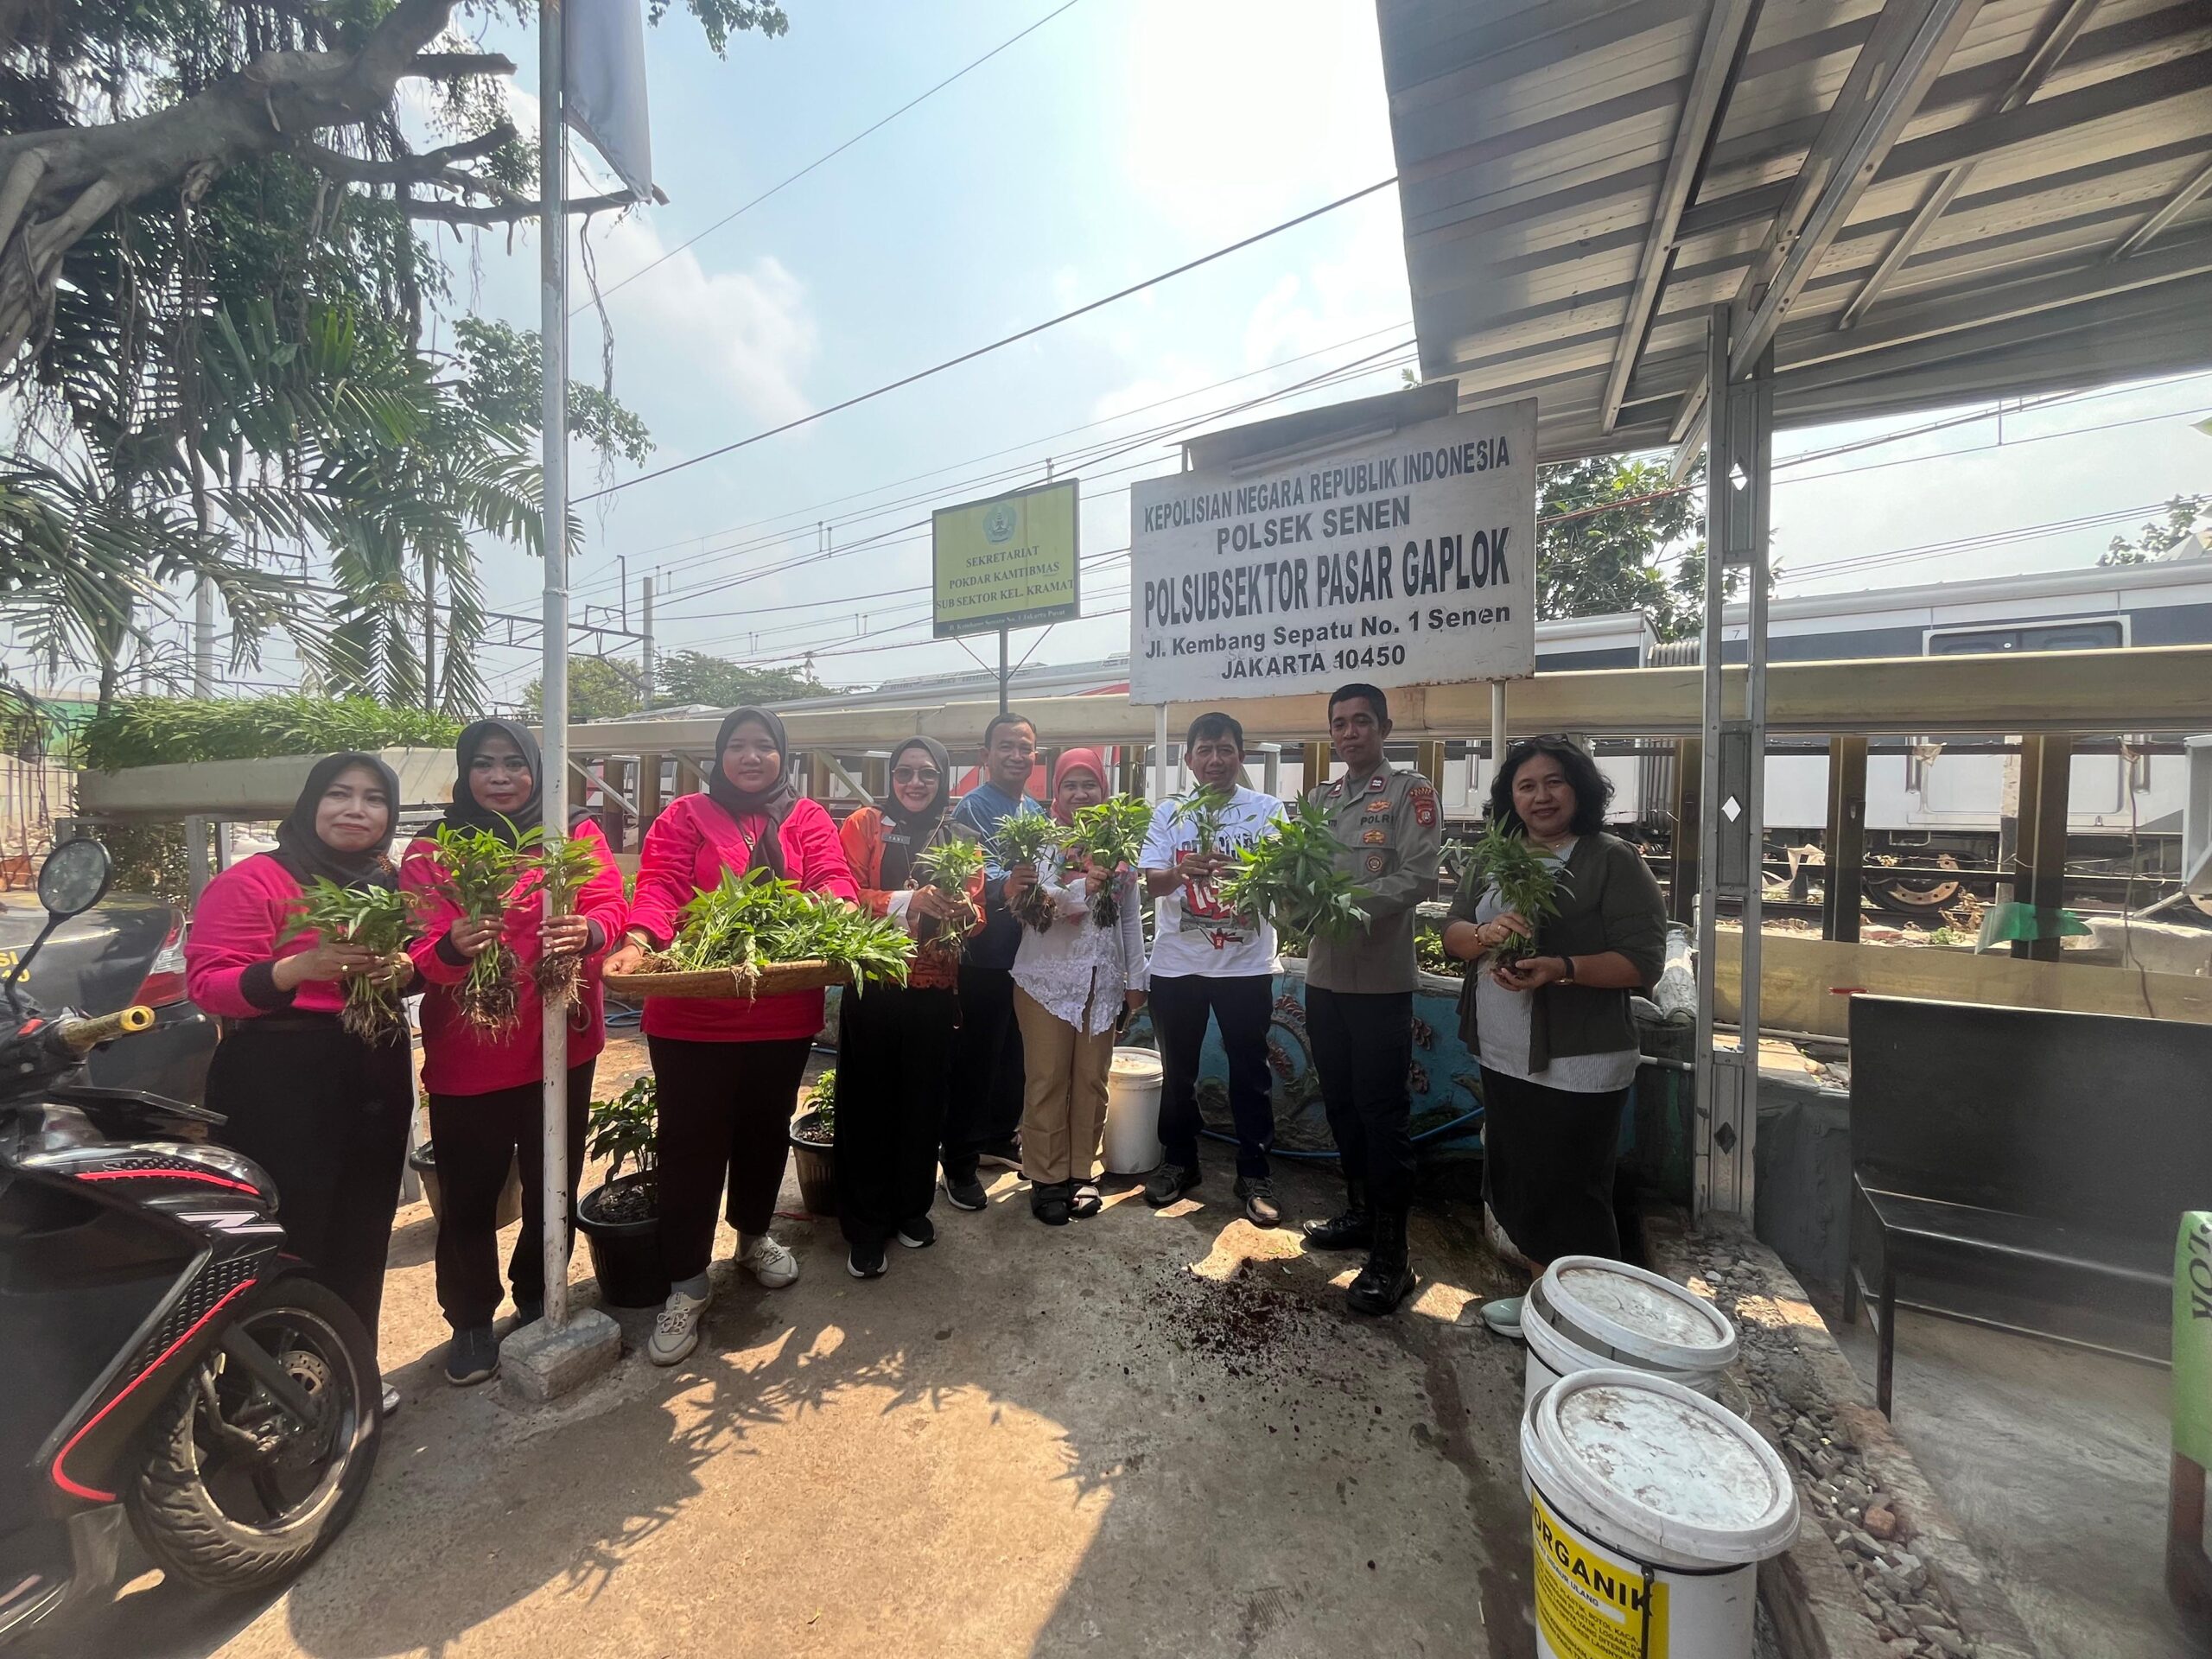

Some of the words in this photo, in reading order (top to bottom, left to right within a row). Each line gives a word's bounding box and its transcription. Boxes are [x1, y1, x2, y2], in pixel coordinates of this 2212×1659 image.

[1144, 491, 1232, 532] KEPOLISIAN
[1236, 480, 1303, 516] NEGARA
[1310, 458, 1398, 501] REPUBLIK
[1403, 436, 1510, 481] INDONESIA
[1217, 512, 1313, 555] POLSEK
[1322, 496, 1410, 537] SENEN
[966, 545, 1039, 568] SEKRETARIAT
[949, 574, 991, 589] POKDAR
[994, 562, 1060, 582] KAMTIBMAS
[1144, 558, 1308, 628] POLSUBSEKTOR
[1318, 545, 1394, 607] PASAR
[1402, 527, 1510, 597] GAPLOK
[936, 599, 955, 610] SUB
[957, 592, 997, 607] SEKTOR
[1001, 588, 1023, 600] KEL.
[1027, 579, 1073, 596] KRAMAT
[1145, 639, 1166, 659] Jl.
[1173, 632, 1266, 656] Kembang
[1273, 620, 1353, 646] Sepatu
[1361, 615, 1400, 637] No.
[1408, 611, 1420, 631] 1
[1427, 605, 1511, 629] Senen
[1732, 629, 1740, 639] 7
[1221, 652, 1325, 680] JAKARTA
[1335, 645, 1406, 670] 10450
[1360, 814, 1394, 826] POLRI
[1570, 1580, 1598, 1607] ULANG
